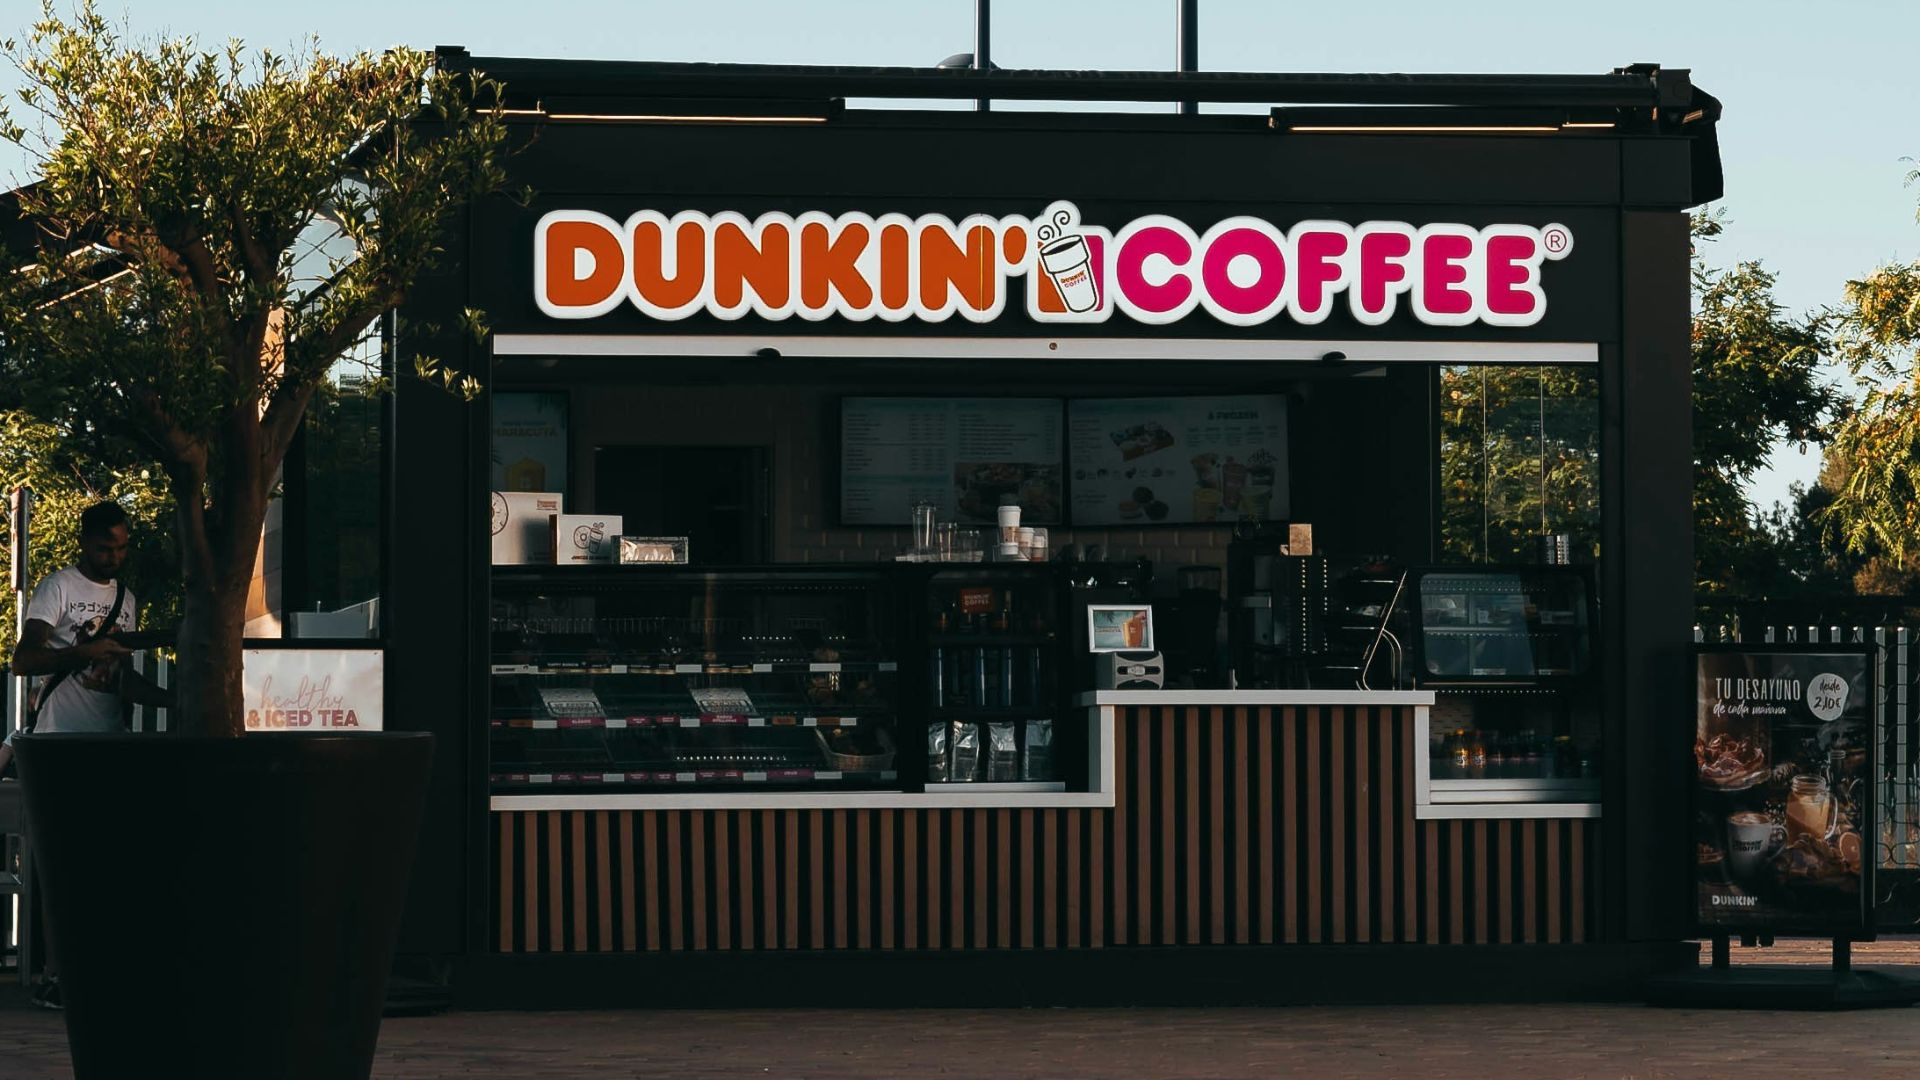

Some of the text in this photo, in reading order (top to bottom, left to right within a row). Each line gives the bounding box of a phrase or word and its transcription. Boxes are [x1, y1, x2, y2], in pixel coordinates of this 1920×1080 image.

[545, 220, 1027, 313] DUNKIN'
[1116, 226, 1536, 314] COFFEE
[1064, 275, 1087, 288] COFFEE
[261, 675, 344, 710] healthy
[1715, 678, 1801, 701] TU DESAYUNO
[1819, 678, 1841, 694] desde
[1713, 699, 1786, 718] de cada mañana
[246, 709, 359, 727] & ICED TEA
[1711, 894, 1758, 906] DUNKIN'
